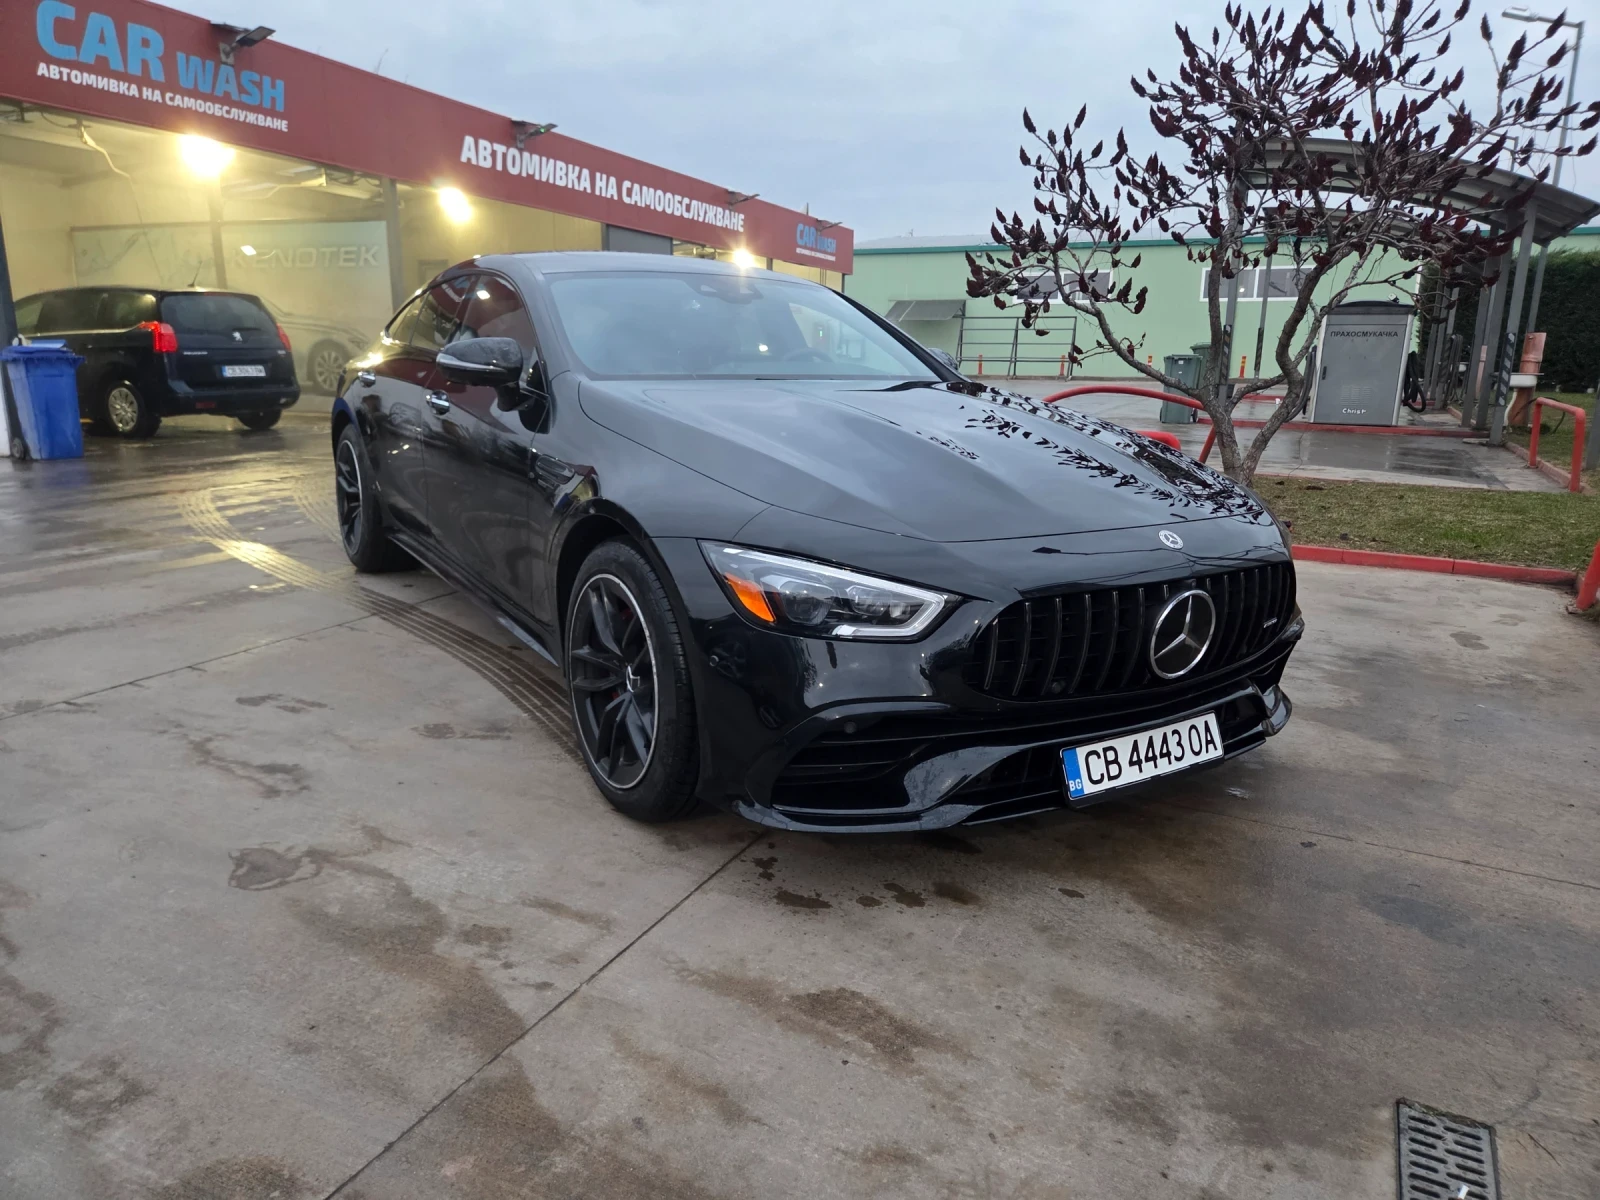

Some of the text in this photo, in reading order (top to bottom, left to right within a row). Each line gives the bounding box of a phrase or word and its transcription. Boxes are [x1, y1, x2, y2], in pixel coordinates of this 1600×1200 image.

[36, 0, 285, 112] CAR WASH
[37, 62, 289, 132] АВТОМИВКА НА САМООБСЛУЖВАНЕ
[460, 135, 745, 232] АВТОМИВКА НА САМООБСЛУЖВАНЕ
[796, 223, 816, 248] CAR
[231, 246, 380, 269] KENOTEK
[1330, 330, 1399, 338] ПРАХОСМУКАЧКА
[1085, 746, 1122, 785] CB
[1128, 729, 1185, 774] 4443
[1069, 780, 1082, 791] BG
